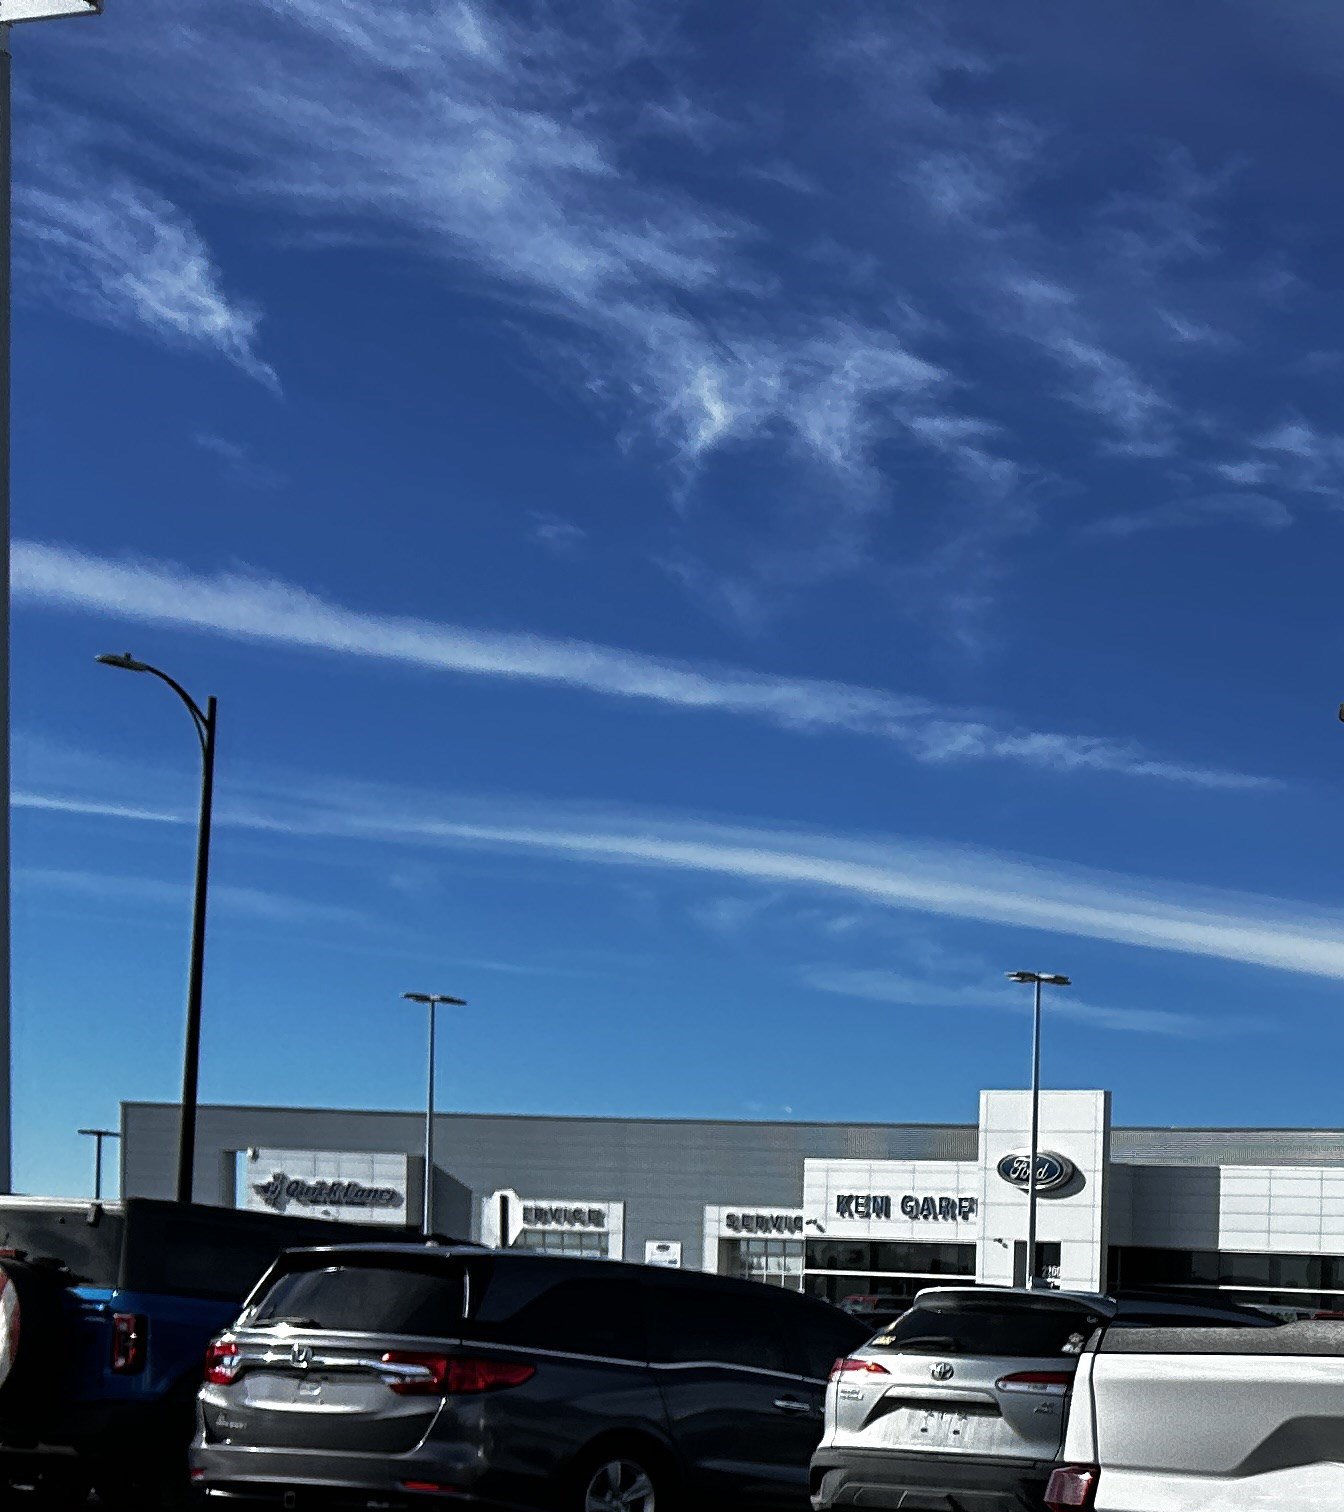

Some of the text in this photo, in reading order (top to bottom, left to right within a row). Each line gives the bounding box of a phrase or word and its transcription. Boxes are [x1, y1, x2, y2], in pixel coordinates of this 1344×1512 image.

[1009, 1156, 1050, 1180] Fod
[836, 1194, 979, 1221] KEN GARF
[725, 1213, 804, 1233] SERVIC
